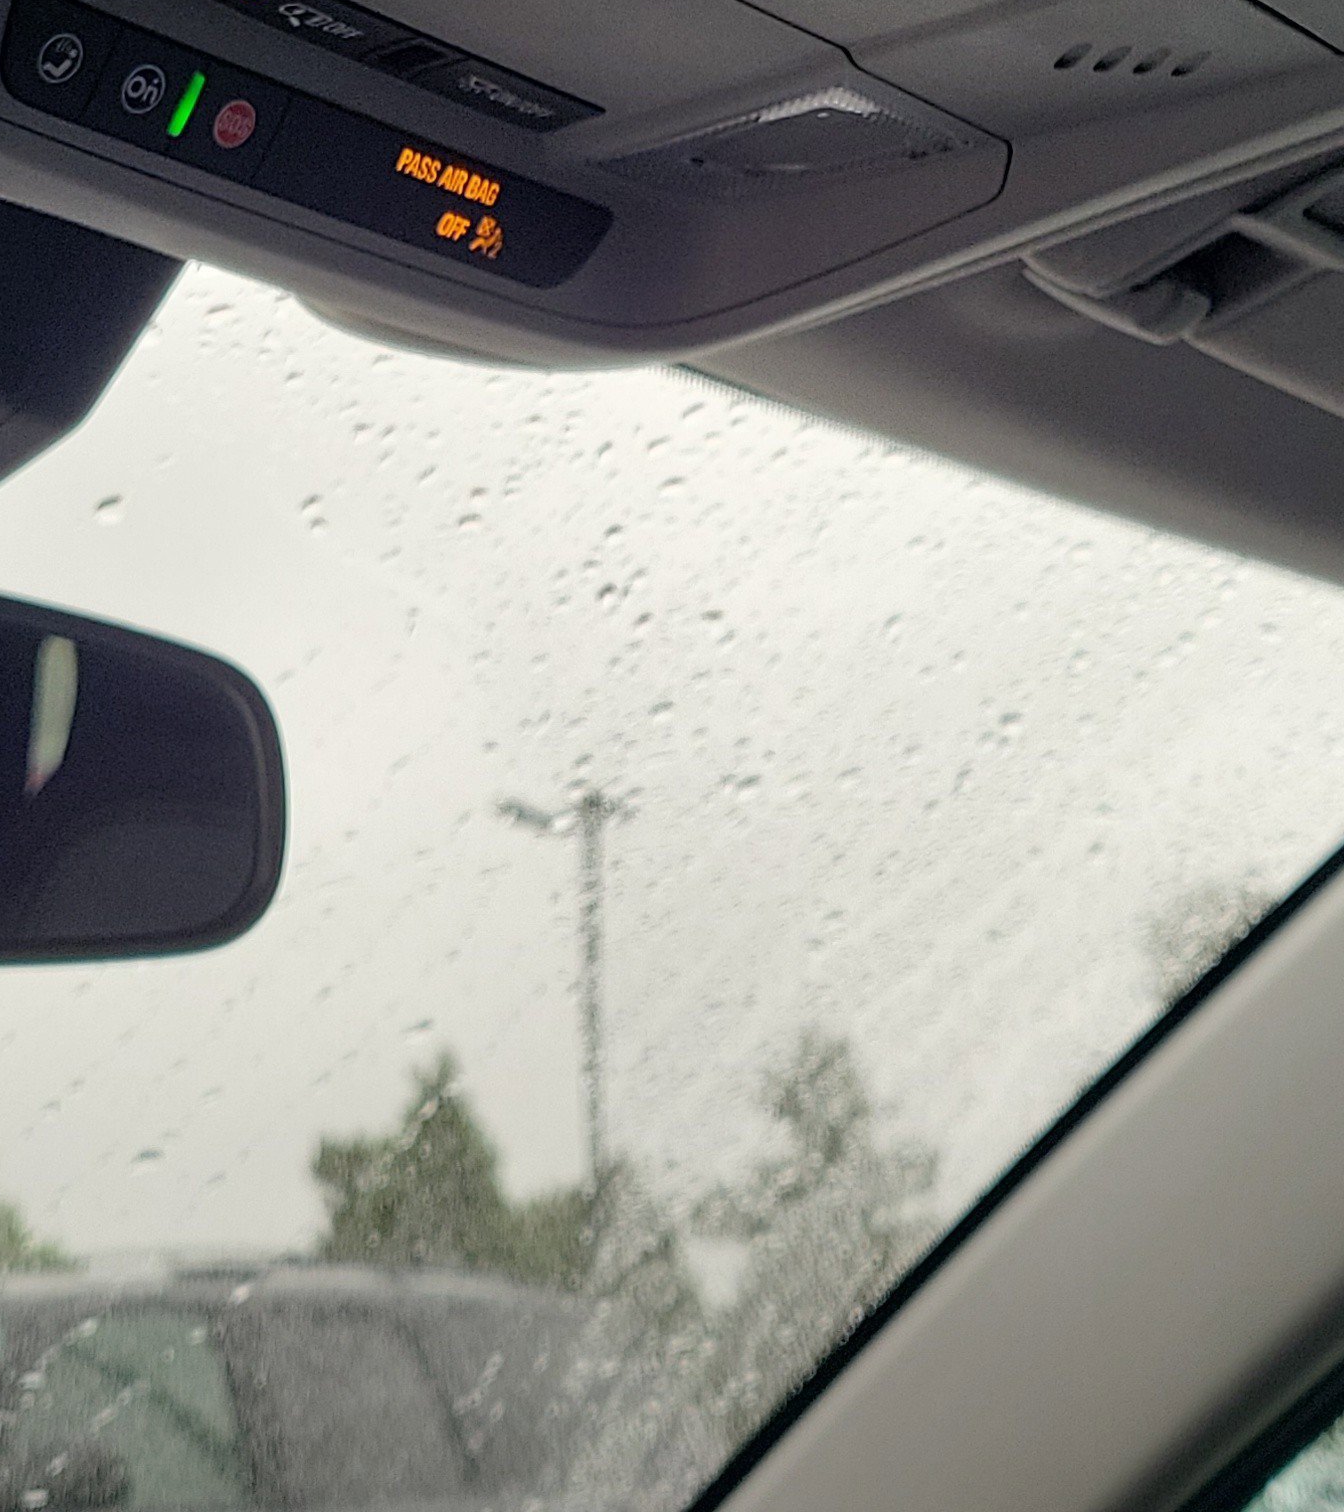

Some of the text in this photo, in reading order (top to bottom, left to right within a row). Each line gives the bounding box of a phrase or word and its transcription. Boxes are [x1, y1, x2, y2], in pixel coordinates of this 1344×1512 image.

[396, 146, 500, 207] PASS AIR BAG
[436, 210, 471, 242] OFF
